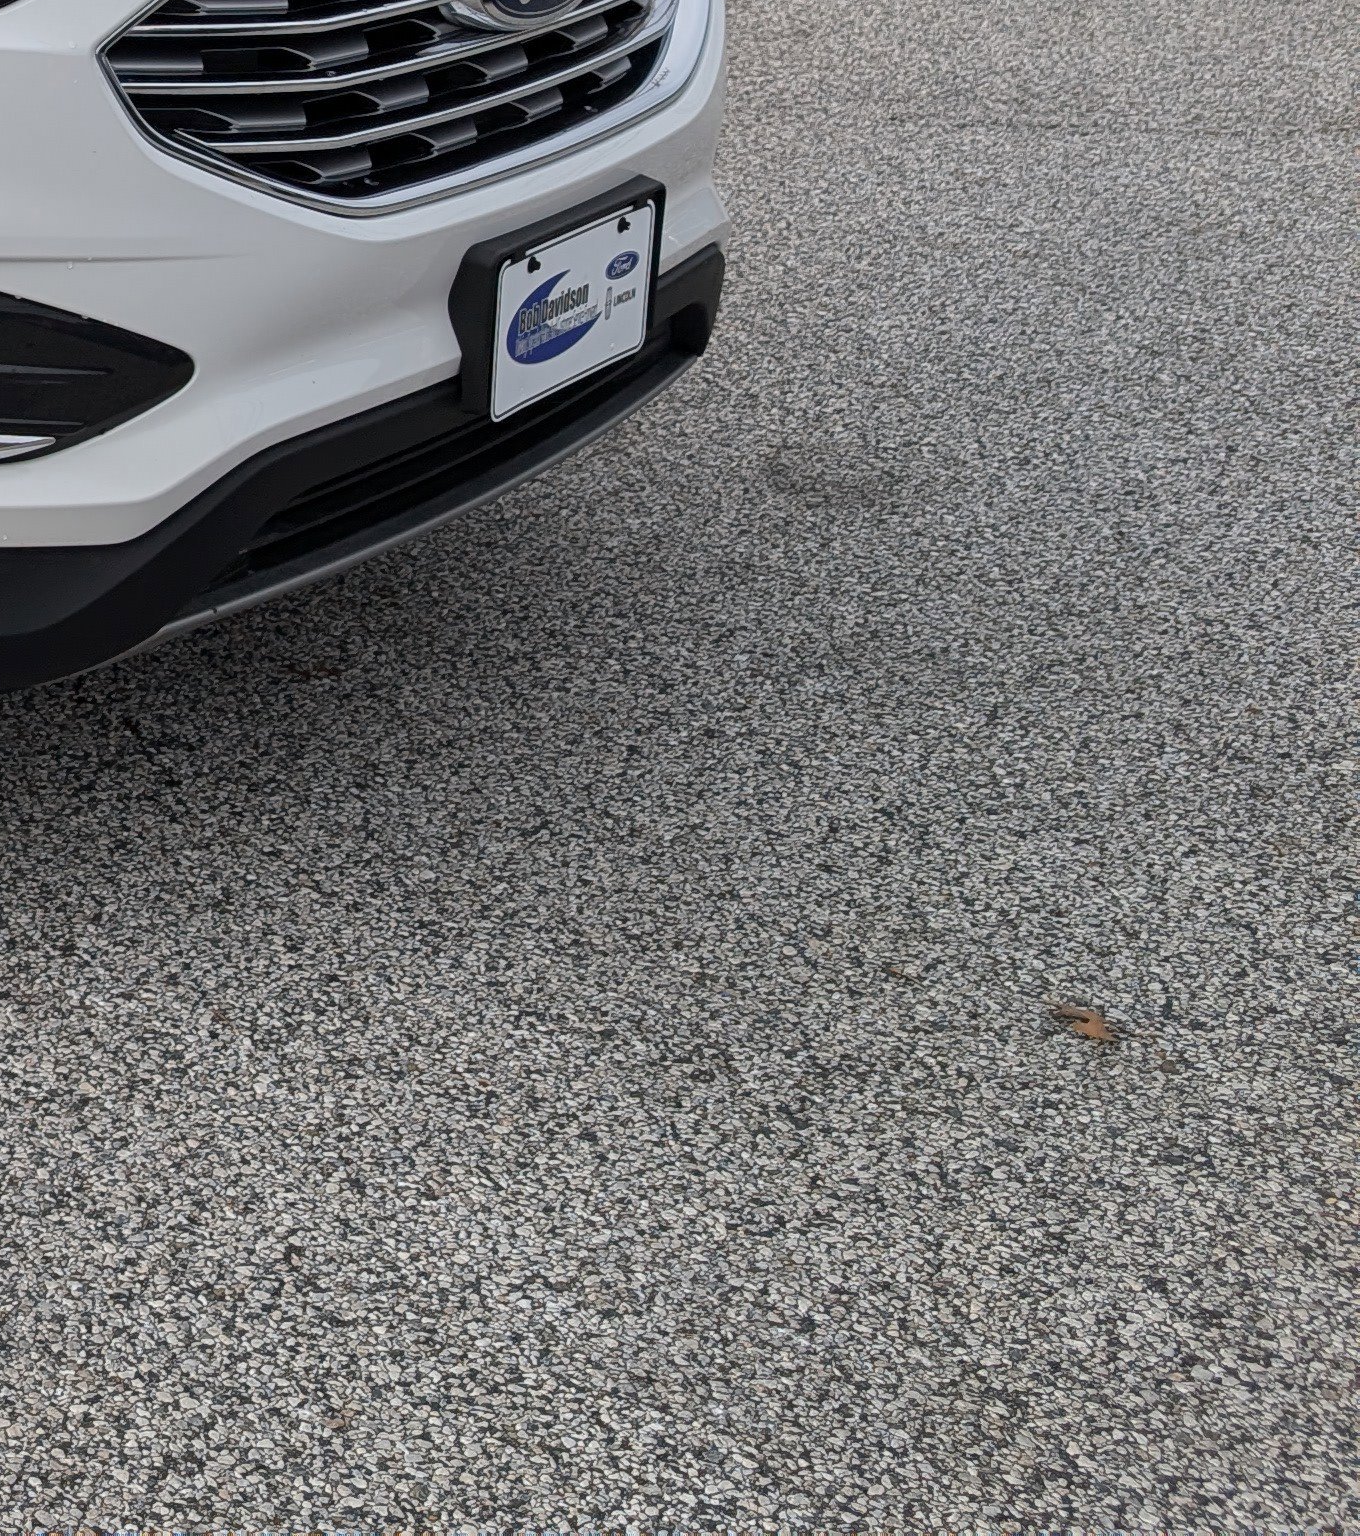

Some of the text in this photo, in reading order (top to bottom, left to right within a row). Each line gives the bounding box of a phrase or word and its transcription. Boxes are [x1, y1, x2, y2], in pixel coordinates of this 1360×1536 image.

[610, 255, 635, 277] Ford
[518, 305, 542, 335] Bob
[539, 283, 591, 326] Davidson
